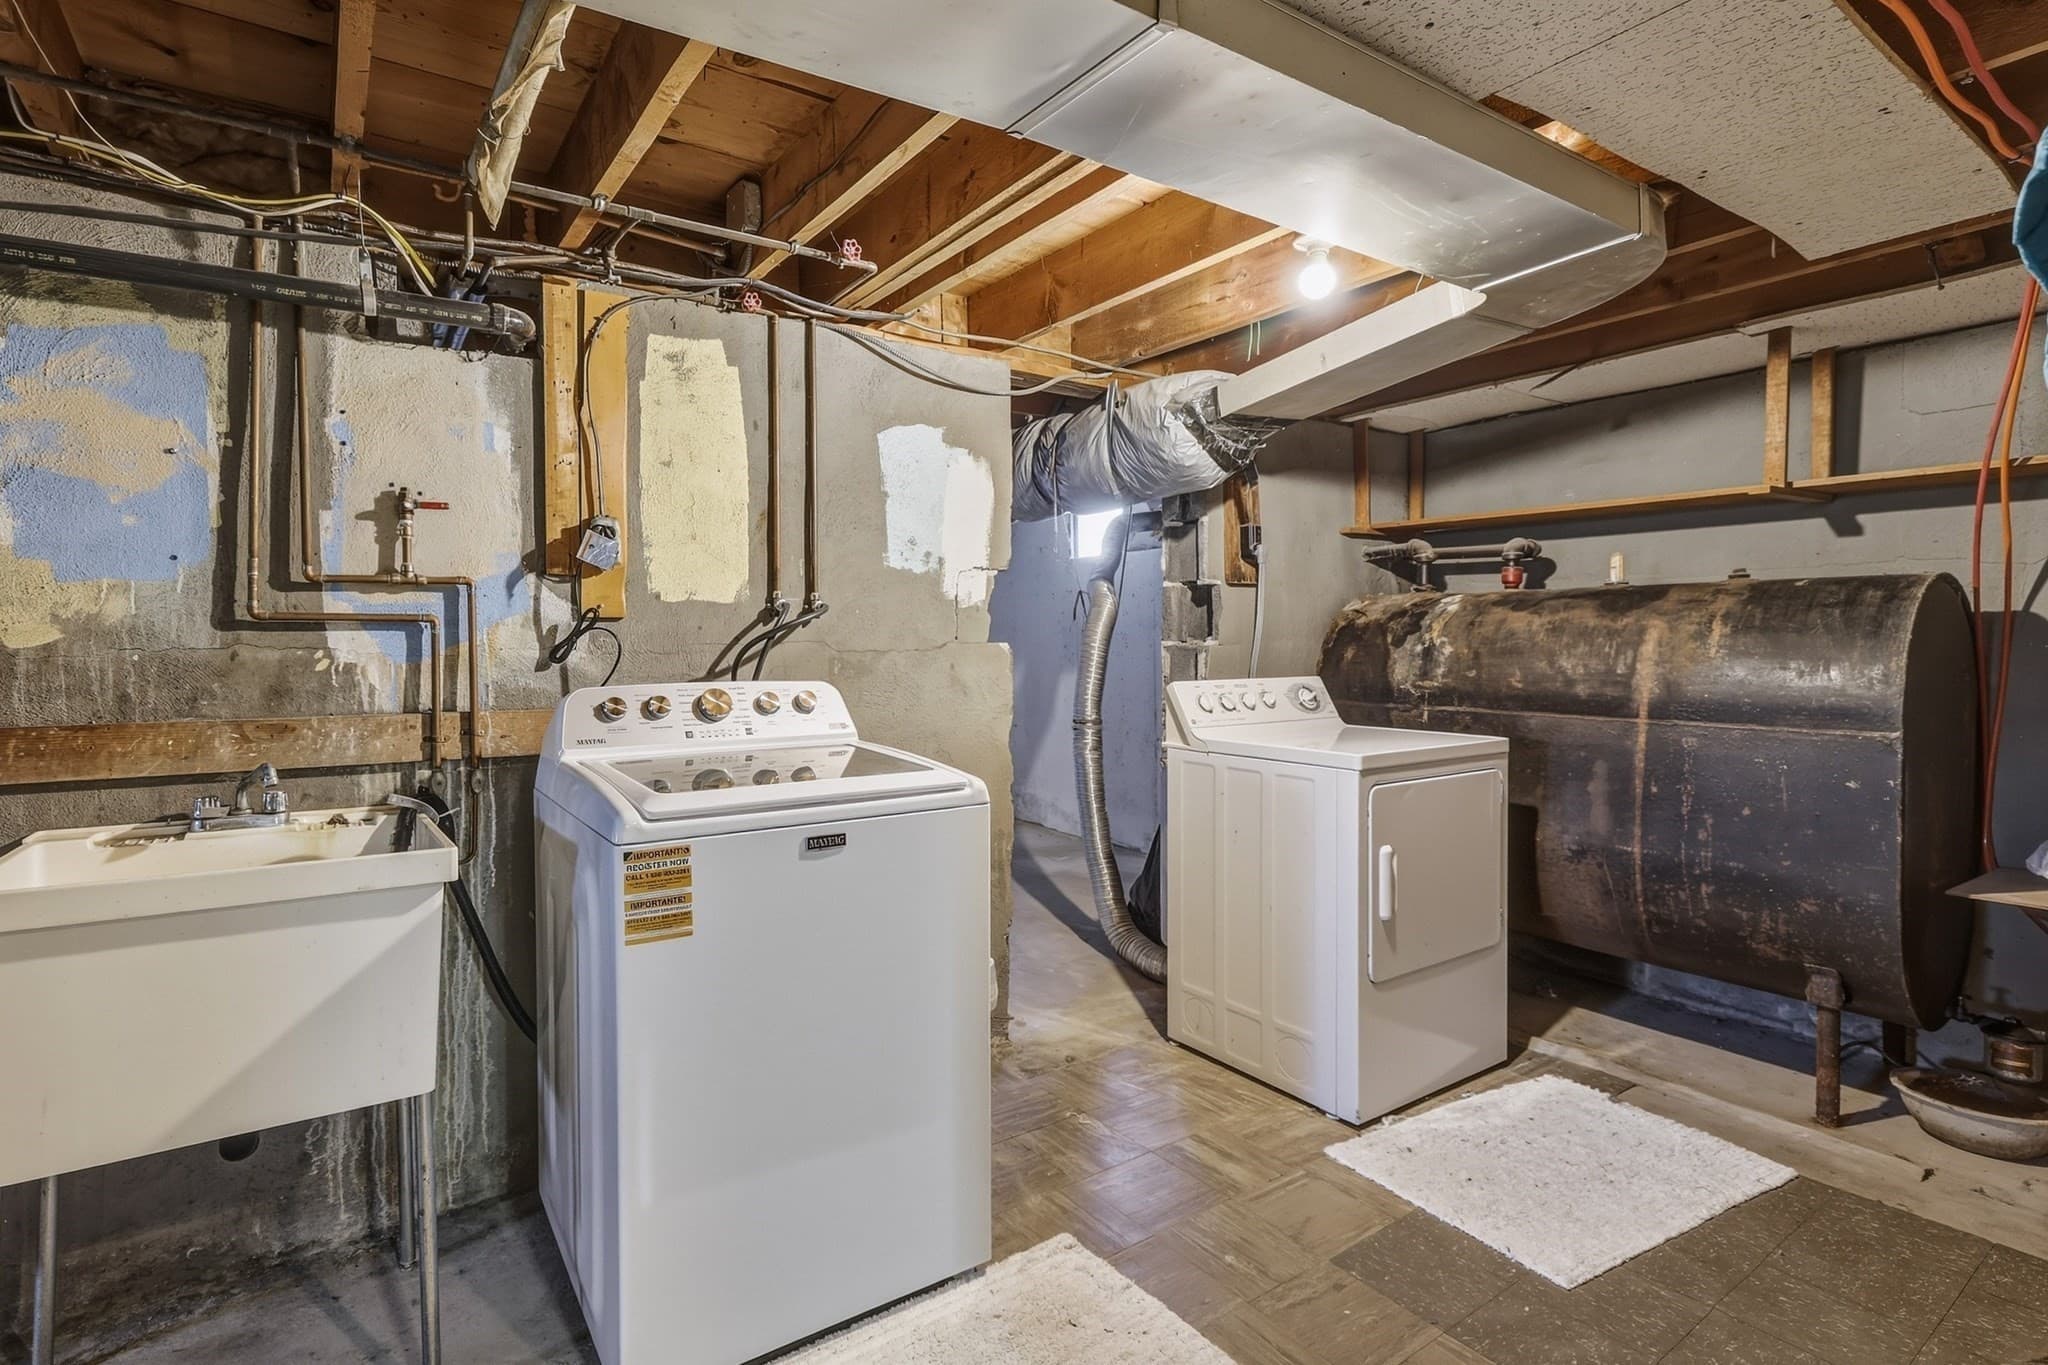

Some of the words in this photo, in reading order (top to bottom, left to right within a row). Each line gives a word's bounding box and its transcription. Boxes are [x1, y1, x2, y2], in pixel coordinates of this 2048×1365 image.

[809, 835, 844, 849] MAYTAG
[626, 861, 668, 872] REGISTER
[670, 858, 689, 866] NOW
[625, 873, 644, 881] CALL
